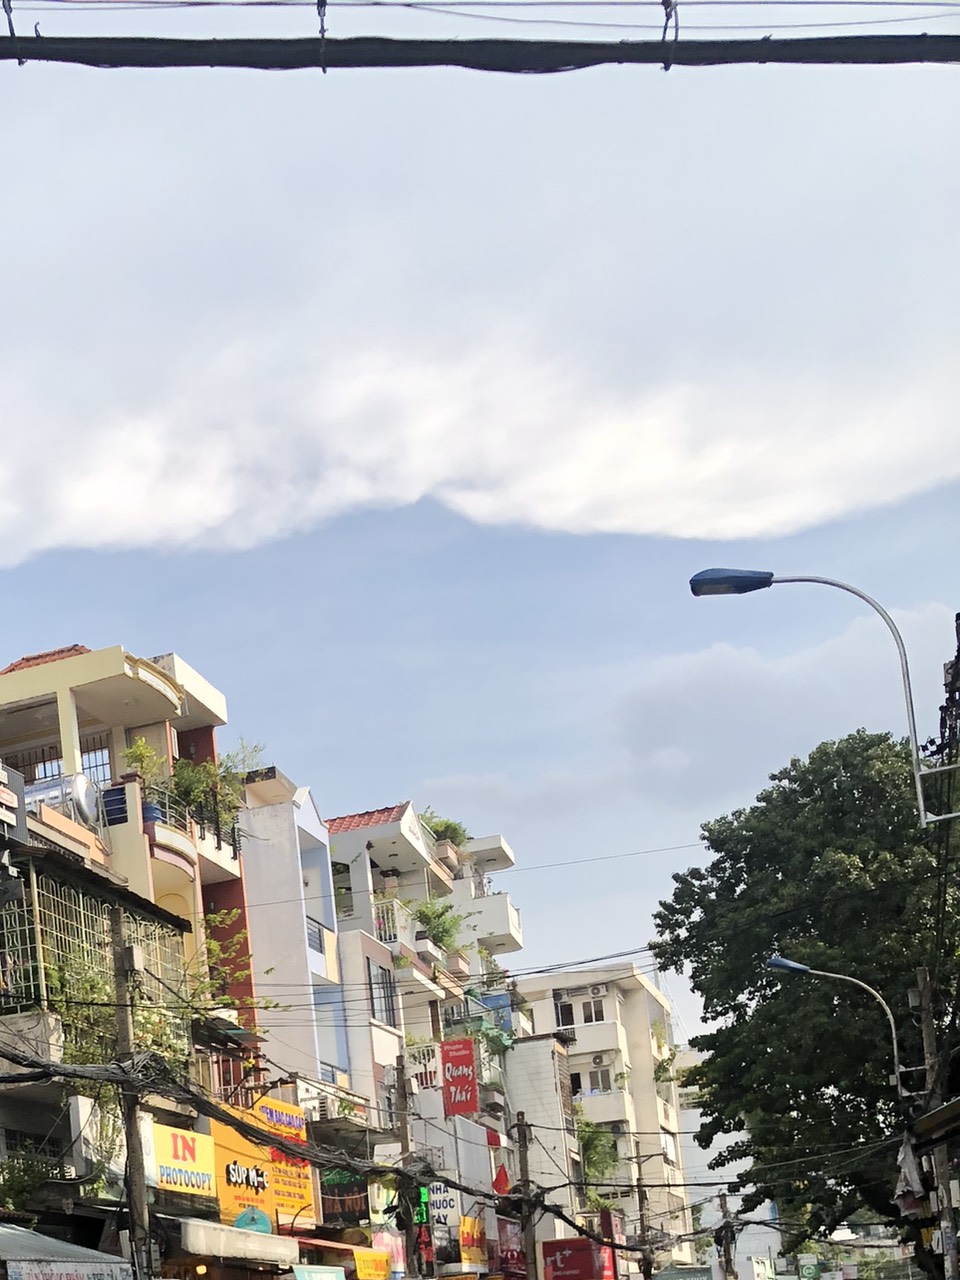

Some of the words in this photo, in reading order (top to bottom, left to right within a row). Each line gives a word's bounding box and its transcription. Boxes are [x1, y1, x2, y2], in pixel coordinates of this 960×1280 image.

[445, 1062, 473, 1082] Quang
[450, 1085, 471, 1103] Thái
[171, 1133, 196, 1163] IN
[159, 1165, 212, 1191] PHOTOCOPY
